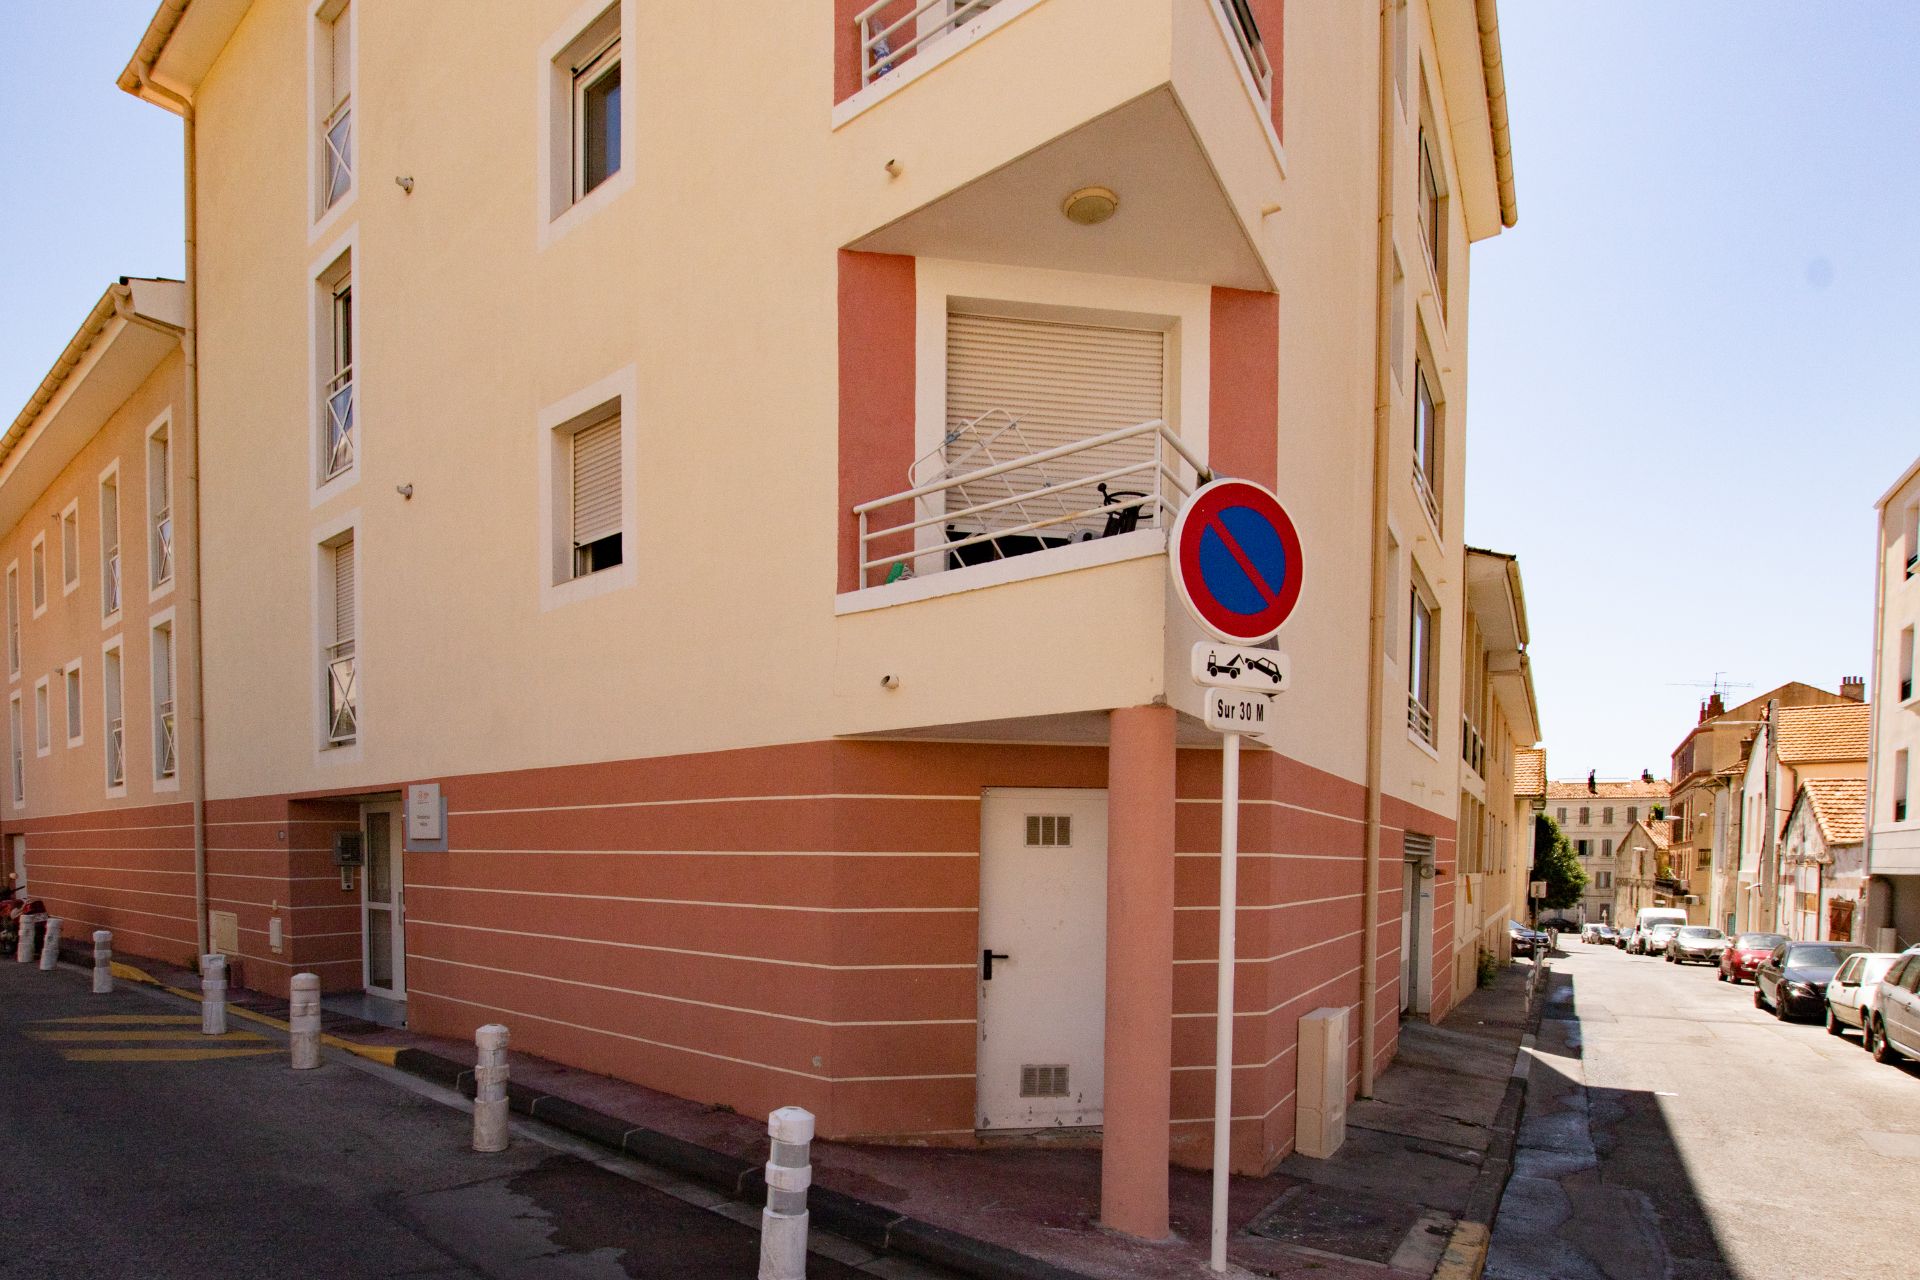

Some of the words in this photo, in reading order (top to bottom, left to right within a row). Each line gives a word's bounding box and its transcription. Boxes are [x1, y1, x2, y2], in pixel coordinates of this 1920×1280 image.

[1217, 698, 1235, 719] Sur
[1240, 701, 1252, 721] 30
[1256, 703, 1264, 722] M
